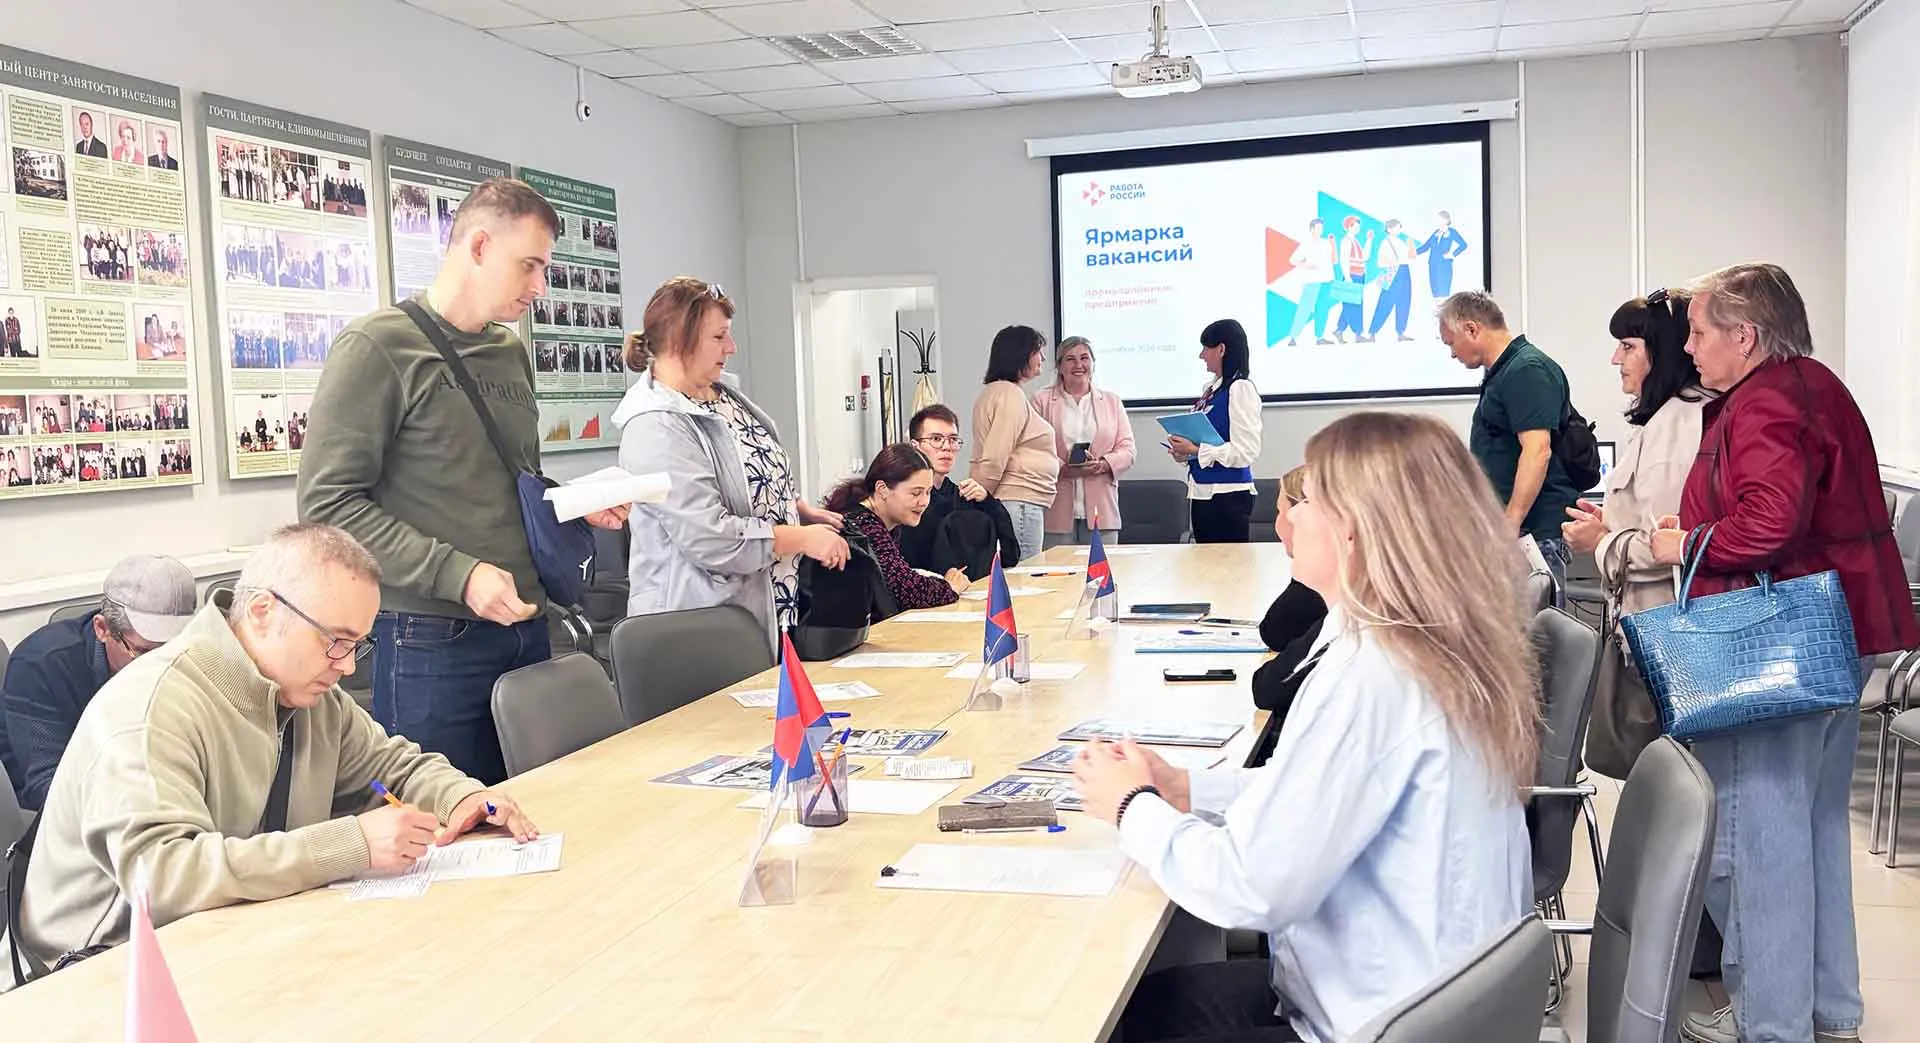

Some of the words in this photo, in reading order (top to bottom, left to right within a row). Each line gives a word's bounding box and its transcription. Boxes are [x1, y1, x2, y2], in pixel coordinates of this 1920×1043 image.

[24, 65, 60, 82] ЦЕНТР
[61, 73, 119, 97] ЗАНЯТОСТИ
[121, 87, 177, 109] НАСЕЛЕНИЯ
[1110, 183, 1144, 192] РАБОТА
[1110, 191, 1146, 200] РОССИИ
[1085, 226, 1184, 248] Ярмарка
[1086, 243, 1193, 267] вакансий
